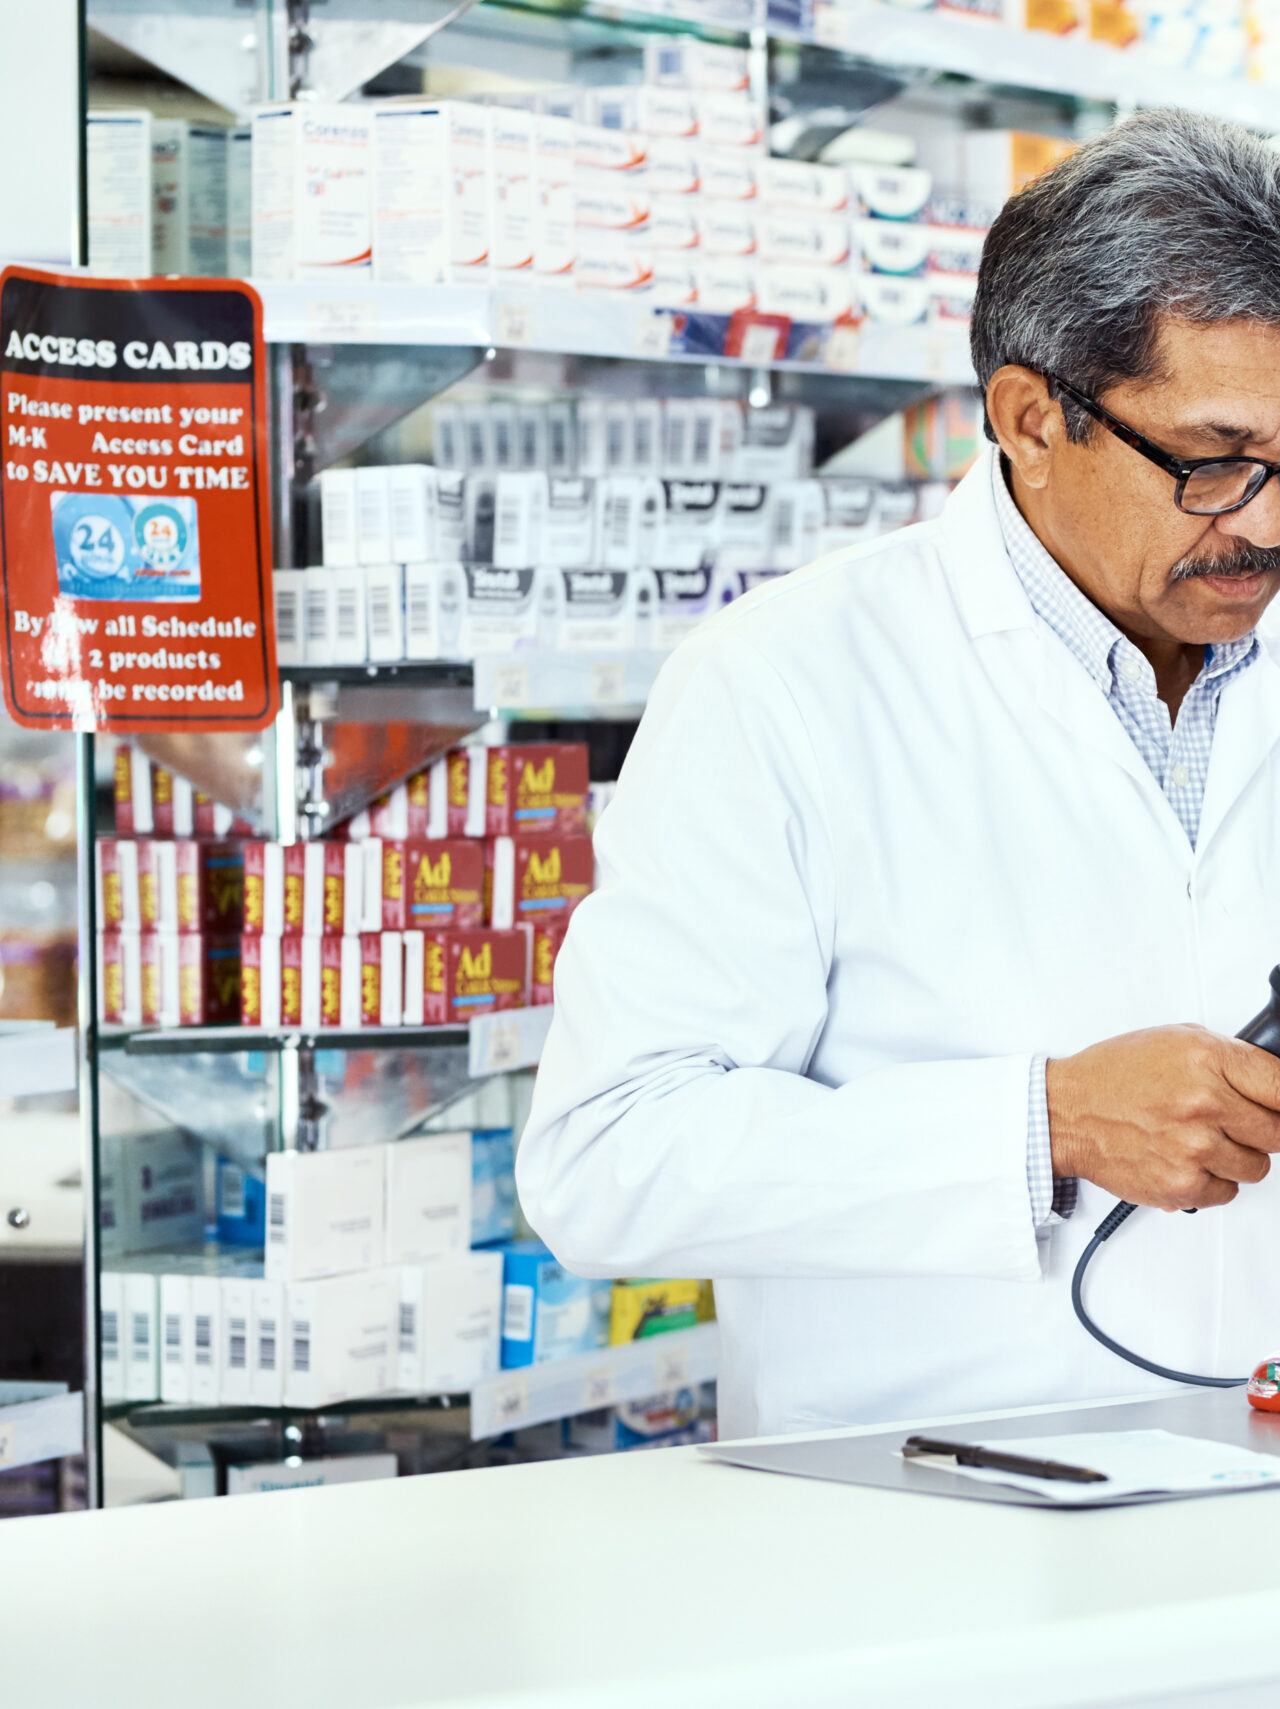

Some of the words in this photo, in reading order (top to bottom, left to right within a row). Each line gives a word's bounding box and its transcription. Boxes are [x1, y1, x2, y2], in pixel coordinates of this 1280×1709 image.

[5, 330, 117, 368] ACCESS
[123, 341, 252, 370] CARDS
[8, 392, 72, 419] Please
[78, 404, 173, 425] present
[179, 406, 244, 428] your
[92, 432, 173, 455] Access
[178, 434, 244, 456] Card
[6, 461, 29, 480] to
[33, 460, 102, 486] SAVE
[107, 464, 168, 488] YOU
[174, 466, 249, 489] TIME
[77, 524, 115, 552] 24
[150, 521, 171, 537] 24
[14, 611, 43, 637] By
[105, 616, 136, 636] all
[142, 615, 256, 637] Schedule
[89, 649, 103, 668] 2
[109, 648, 221, 672] products
[98, 679, 127, 700] be
[132, 680, 244, 700] recorded
[518, 758, 555, 794] Ad
[415, 851, 451, 887] Ad
[522, 847, 561, 884] Ad
[457, 943, 492, 979] Ad
